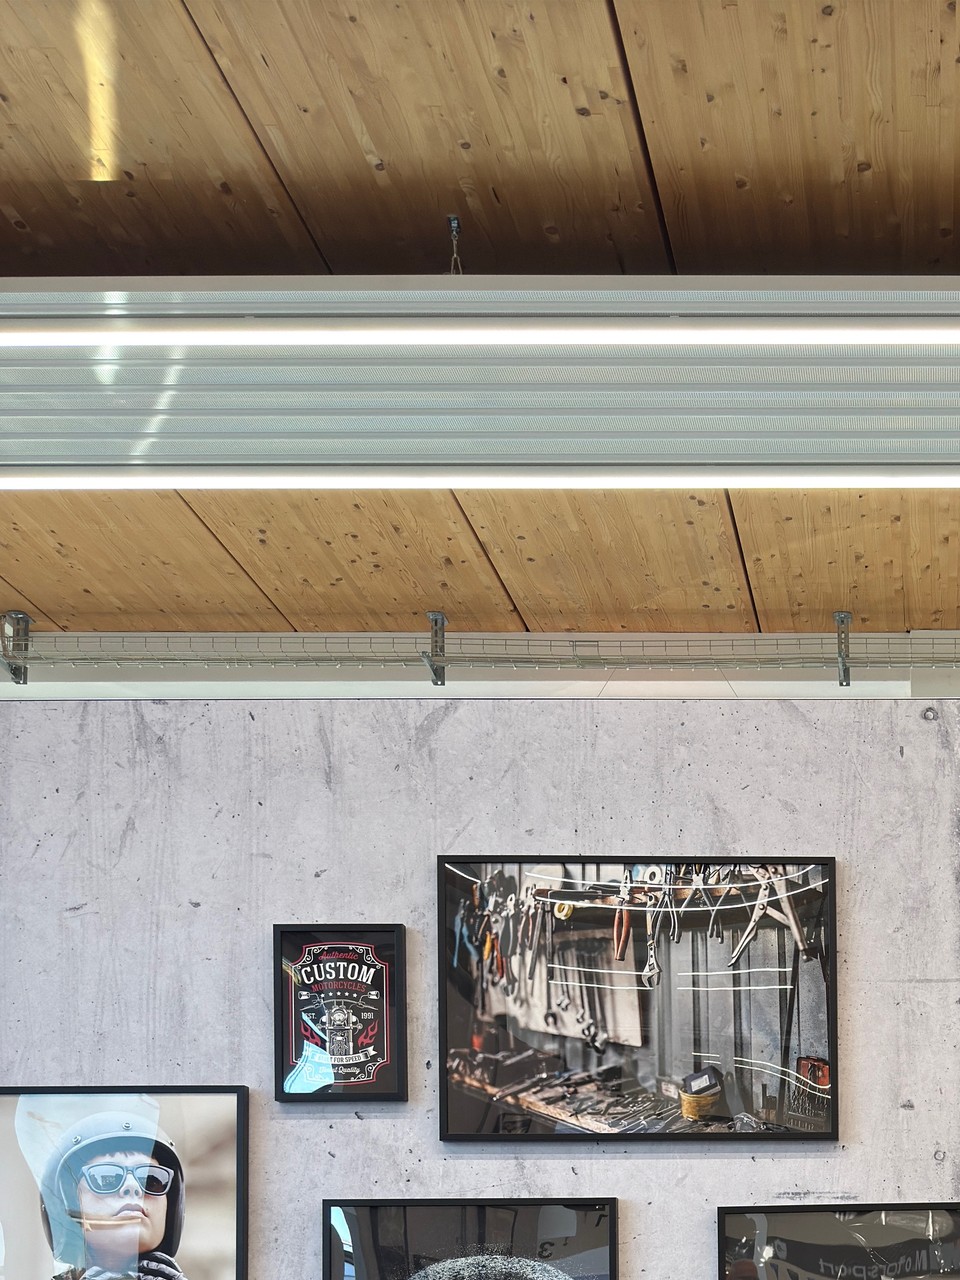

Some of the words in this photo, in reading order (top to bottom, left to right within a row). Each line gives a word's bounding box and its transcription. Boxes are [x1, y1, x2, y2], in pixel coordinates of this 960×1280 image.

[318, 951, 359, 960] Authentic
[301, 962, 376, 985] CUSTOM
[311, 981, 367, 992] MOTORCYCLES
[345, 1054, 361, 1063] SPEED
